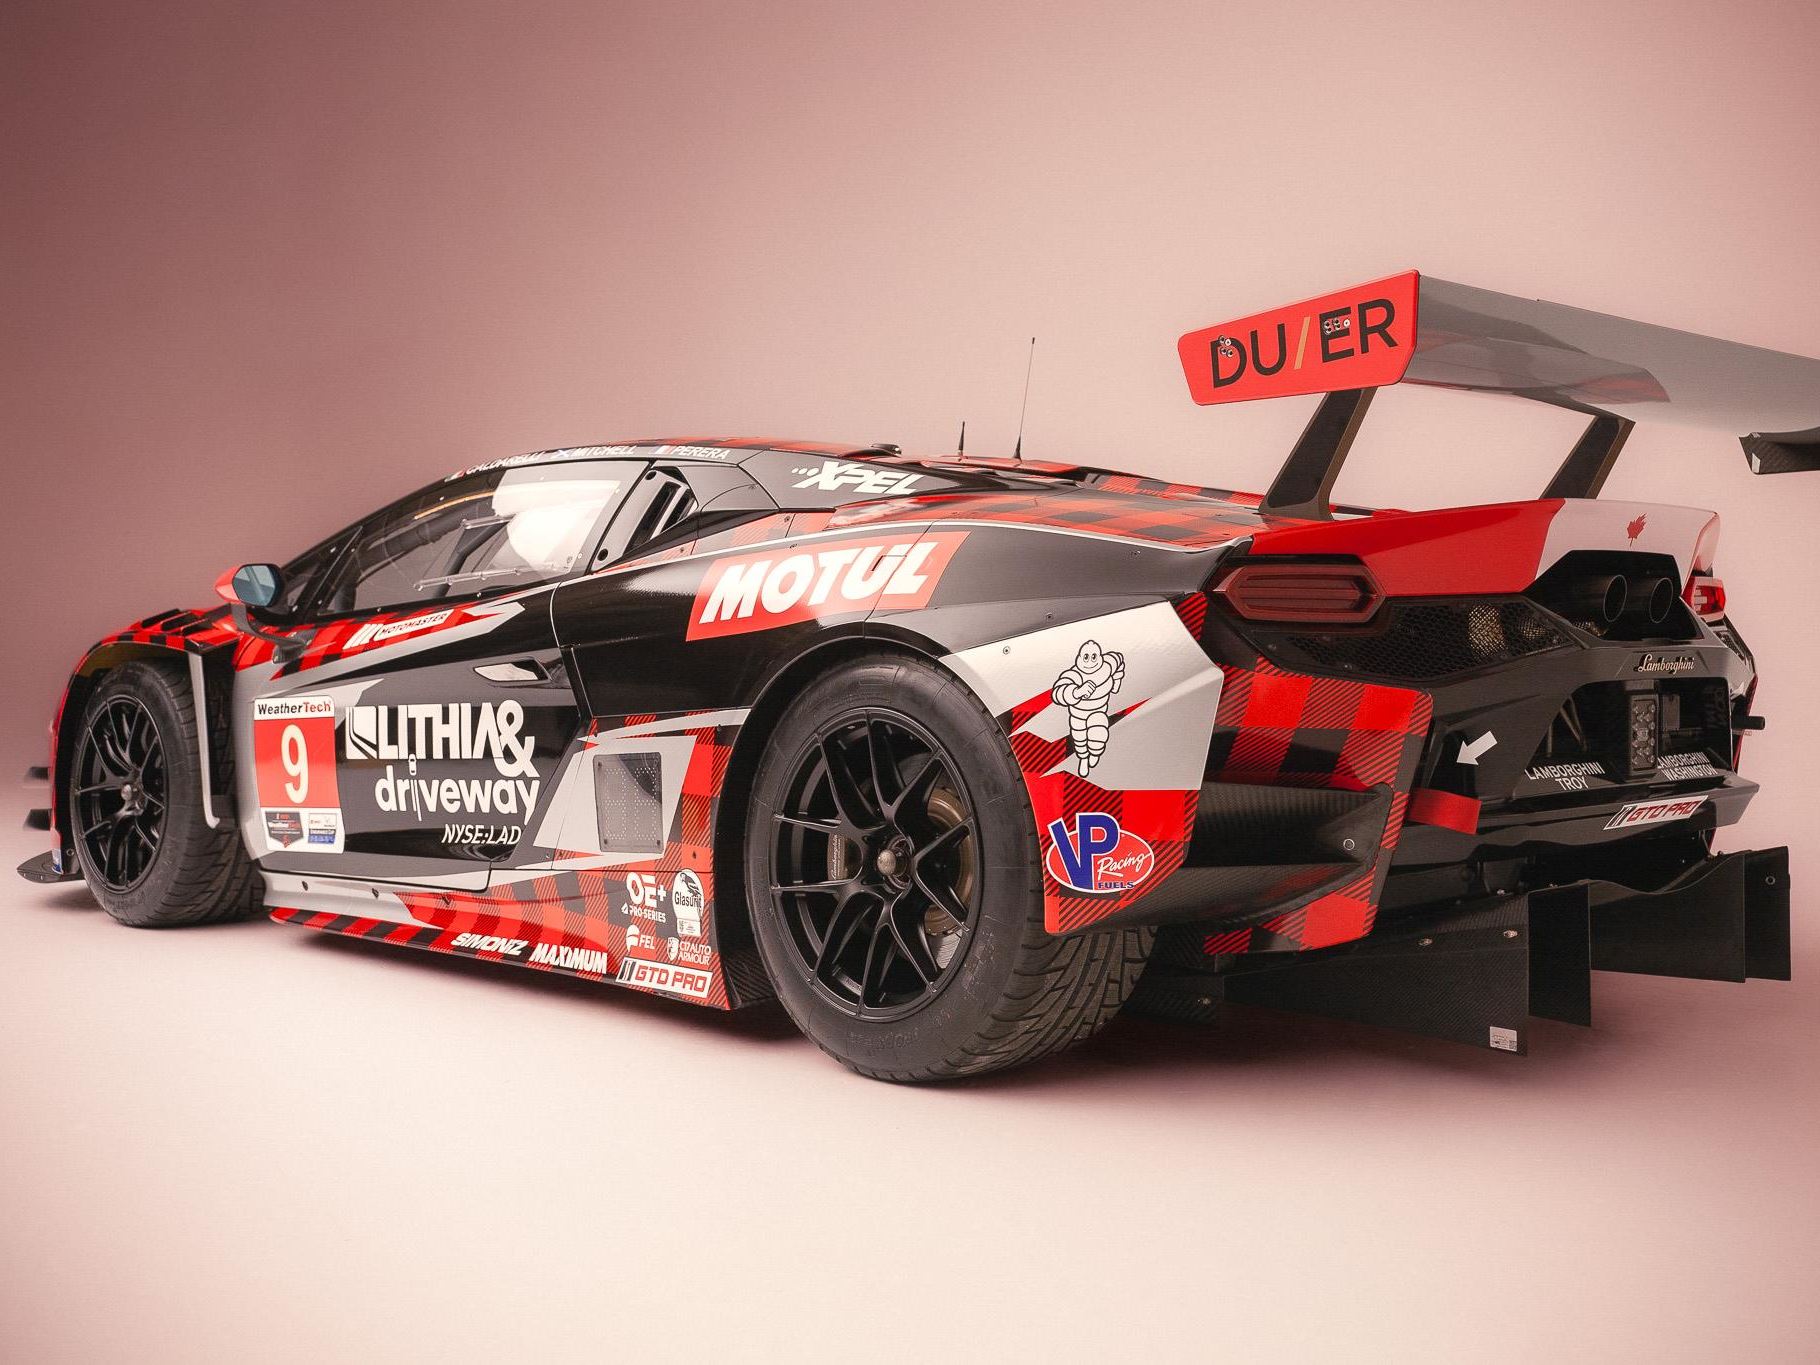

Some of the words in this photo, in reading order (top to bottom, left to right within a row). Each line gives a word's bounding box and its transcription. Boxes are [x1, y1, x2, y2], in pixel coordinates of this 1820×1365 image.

[670, 445, 730, 460] PERERA
[792, 461, 925, 495] XPEL
[699, 542, 938, 625] MOTUL
[380, 613, 448, 635] MOTOMASTER
[1638, 653, 1695, 675] Lamborghini
[258, 701, 331, 715] WeatherTech
[281, 724, 309, 804] 9
[1524, 762, 1605, 781] LAMBORGHINI
[1661, 763, 1718, 781] WASHINGTON
[375, 757, 540, 826] driveway
[1555, 776, 1589, 791] TROY
[1662, 800, 1701, 817] PRO
[441, 824, 521, 845] NYSE:LAD
[1047, 812, 1120, 891] VP
[1097, 852, 1153, 878] Racing
[1098, 881, 1134, 889] FUELS
[629, 905, 667, 923] PRO-SERIES
[639, 934, 655, 951] FEL
[529, 943, 608, 974] MAXIMUM
[671, 972, 707, 992] PRO
